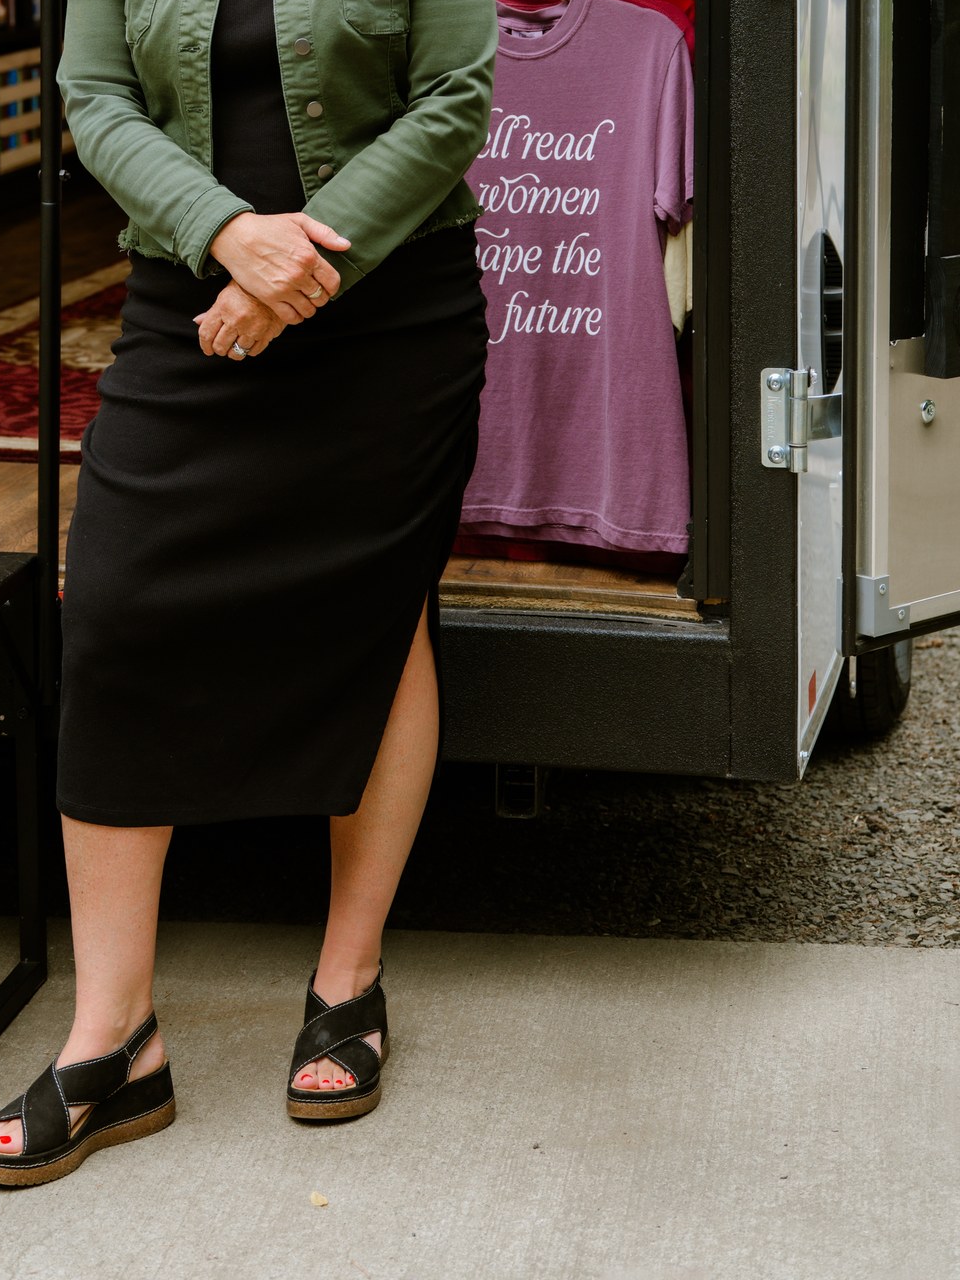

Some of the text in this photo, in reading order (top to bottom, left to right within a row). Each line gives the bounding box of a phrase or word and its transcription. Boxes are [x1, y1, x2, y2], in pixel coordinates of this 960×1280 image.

[476, 108, 616, 161] ell read
[478, 172, 600, 216] women
[474, 227, 602, 286] ape the
[486, 290, 603, 345] future
